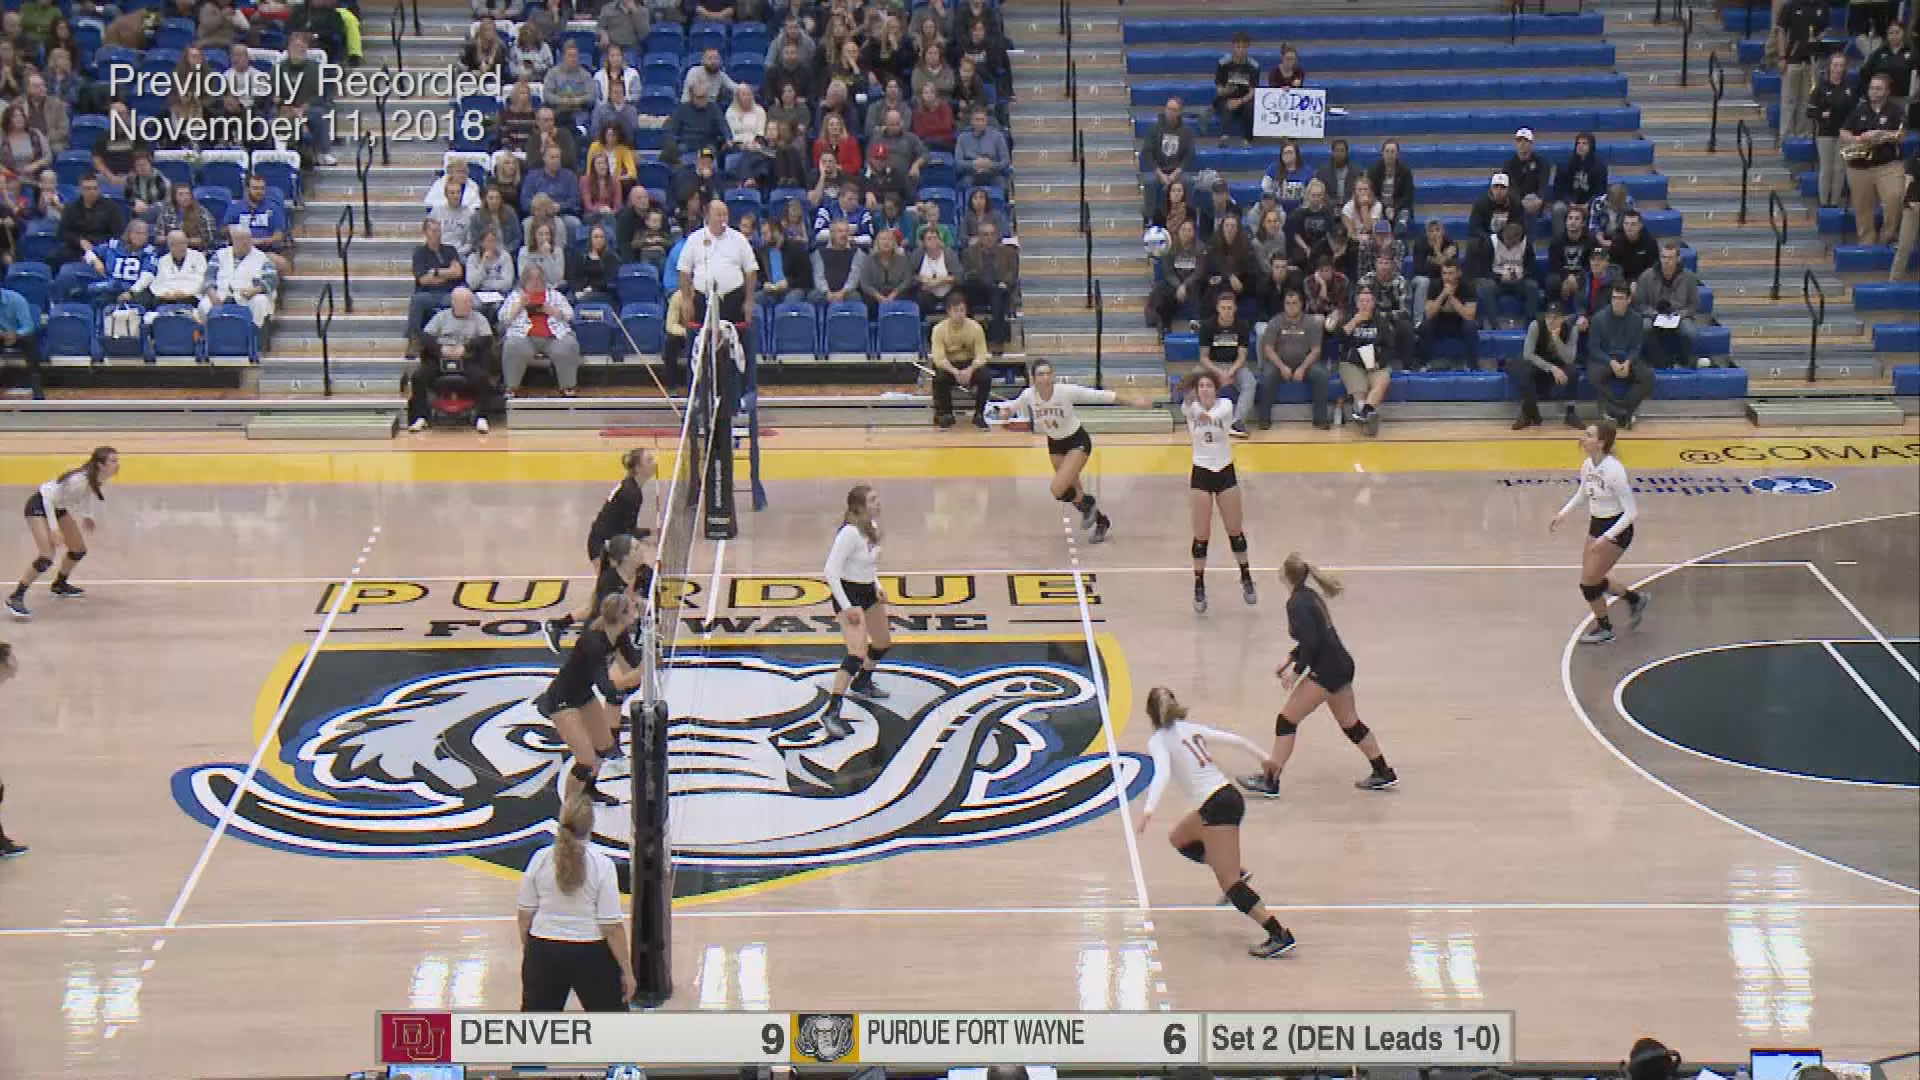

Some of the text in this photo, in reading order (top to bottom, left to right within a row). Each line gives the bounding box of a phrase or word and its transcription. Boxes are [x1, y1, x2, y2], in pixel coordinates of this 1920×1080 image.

[113, 257, 141, 281] 12
[1204, 431, 1213, 443] 3
[1182, 733, 1213, 768] 10
